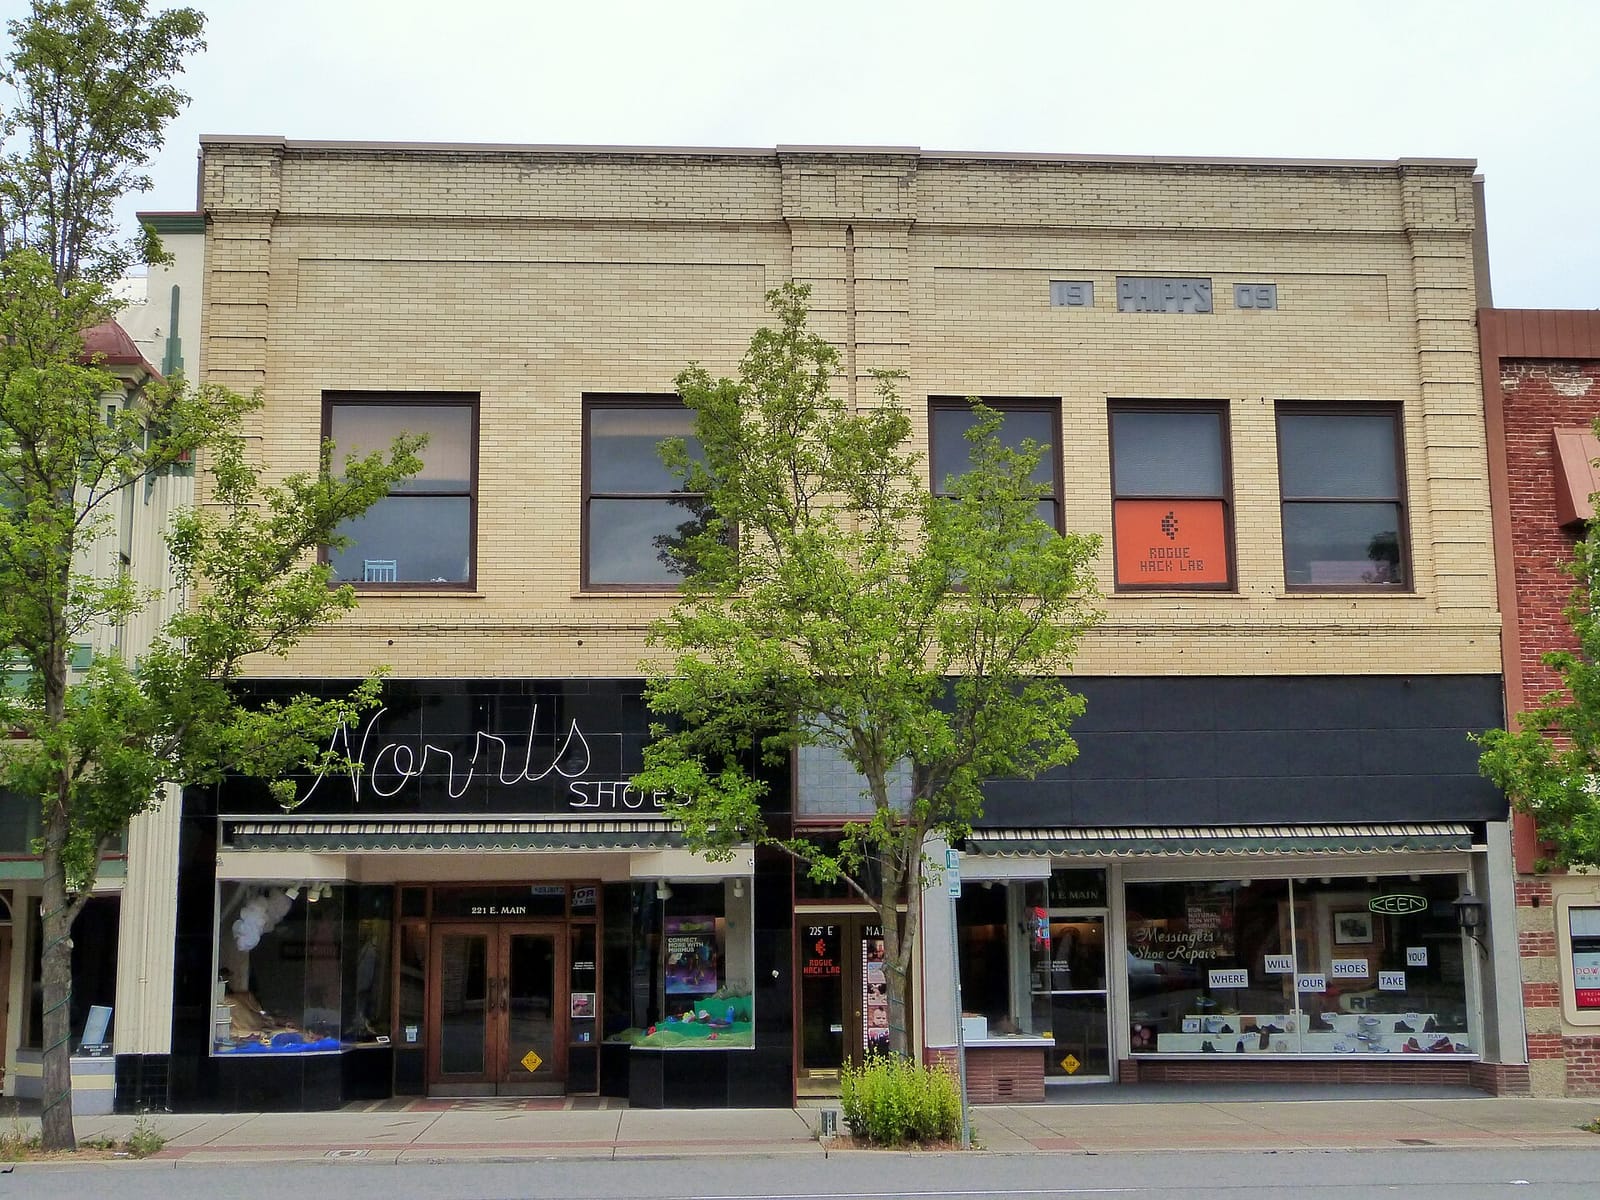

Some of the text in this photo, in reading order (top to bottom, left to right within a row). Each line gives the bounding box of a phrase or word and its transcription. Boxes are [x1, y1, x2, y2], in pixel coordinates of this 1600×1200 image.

[1058, 285, 1085, 306] 19
[1117, 281, 1211, 312] PHIPPS
[1149, 547, 1190, 559] ROGUE
[1140, 560, 1204, 572] HACK LAB
[279, 703, 591, 809] Norris
[569, 781, 692, 808] SHOES
[1069, 890, 1098, 900] MAIN
[471, 906, 527, 914] 221 E. MAIN
[1371, 897, 1425, 912] KEEN
[809, 926, 886, 936] 225 E MAI
[1135, 945, 1217, 965] Shoe Repair
[803, 967, 841, 975] HACK LAB
[1211, 974, 1245, 984] WHERE
[1267, 960, 1290, 969] WILL
[1334, 964, 1367, 973] SHOES
[1381, 977, 1404, 986] TAKE
[1408, 952, 1426, 962] YOU?
[1576, 967, 1599, 975] DOW
